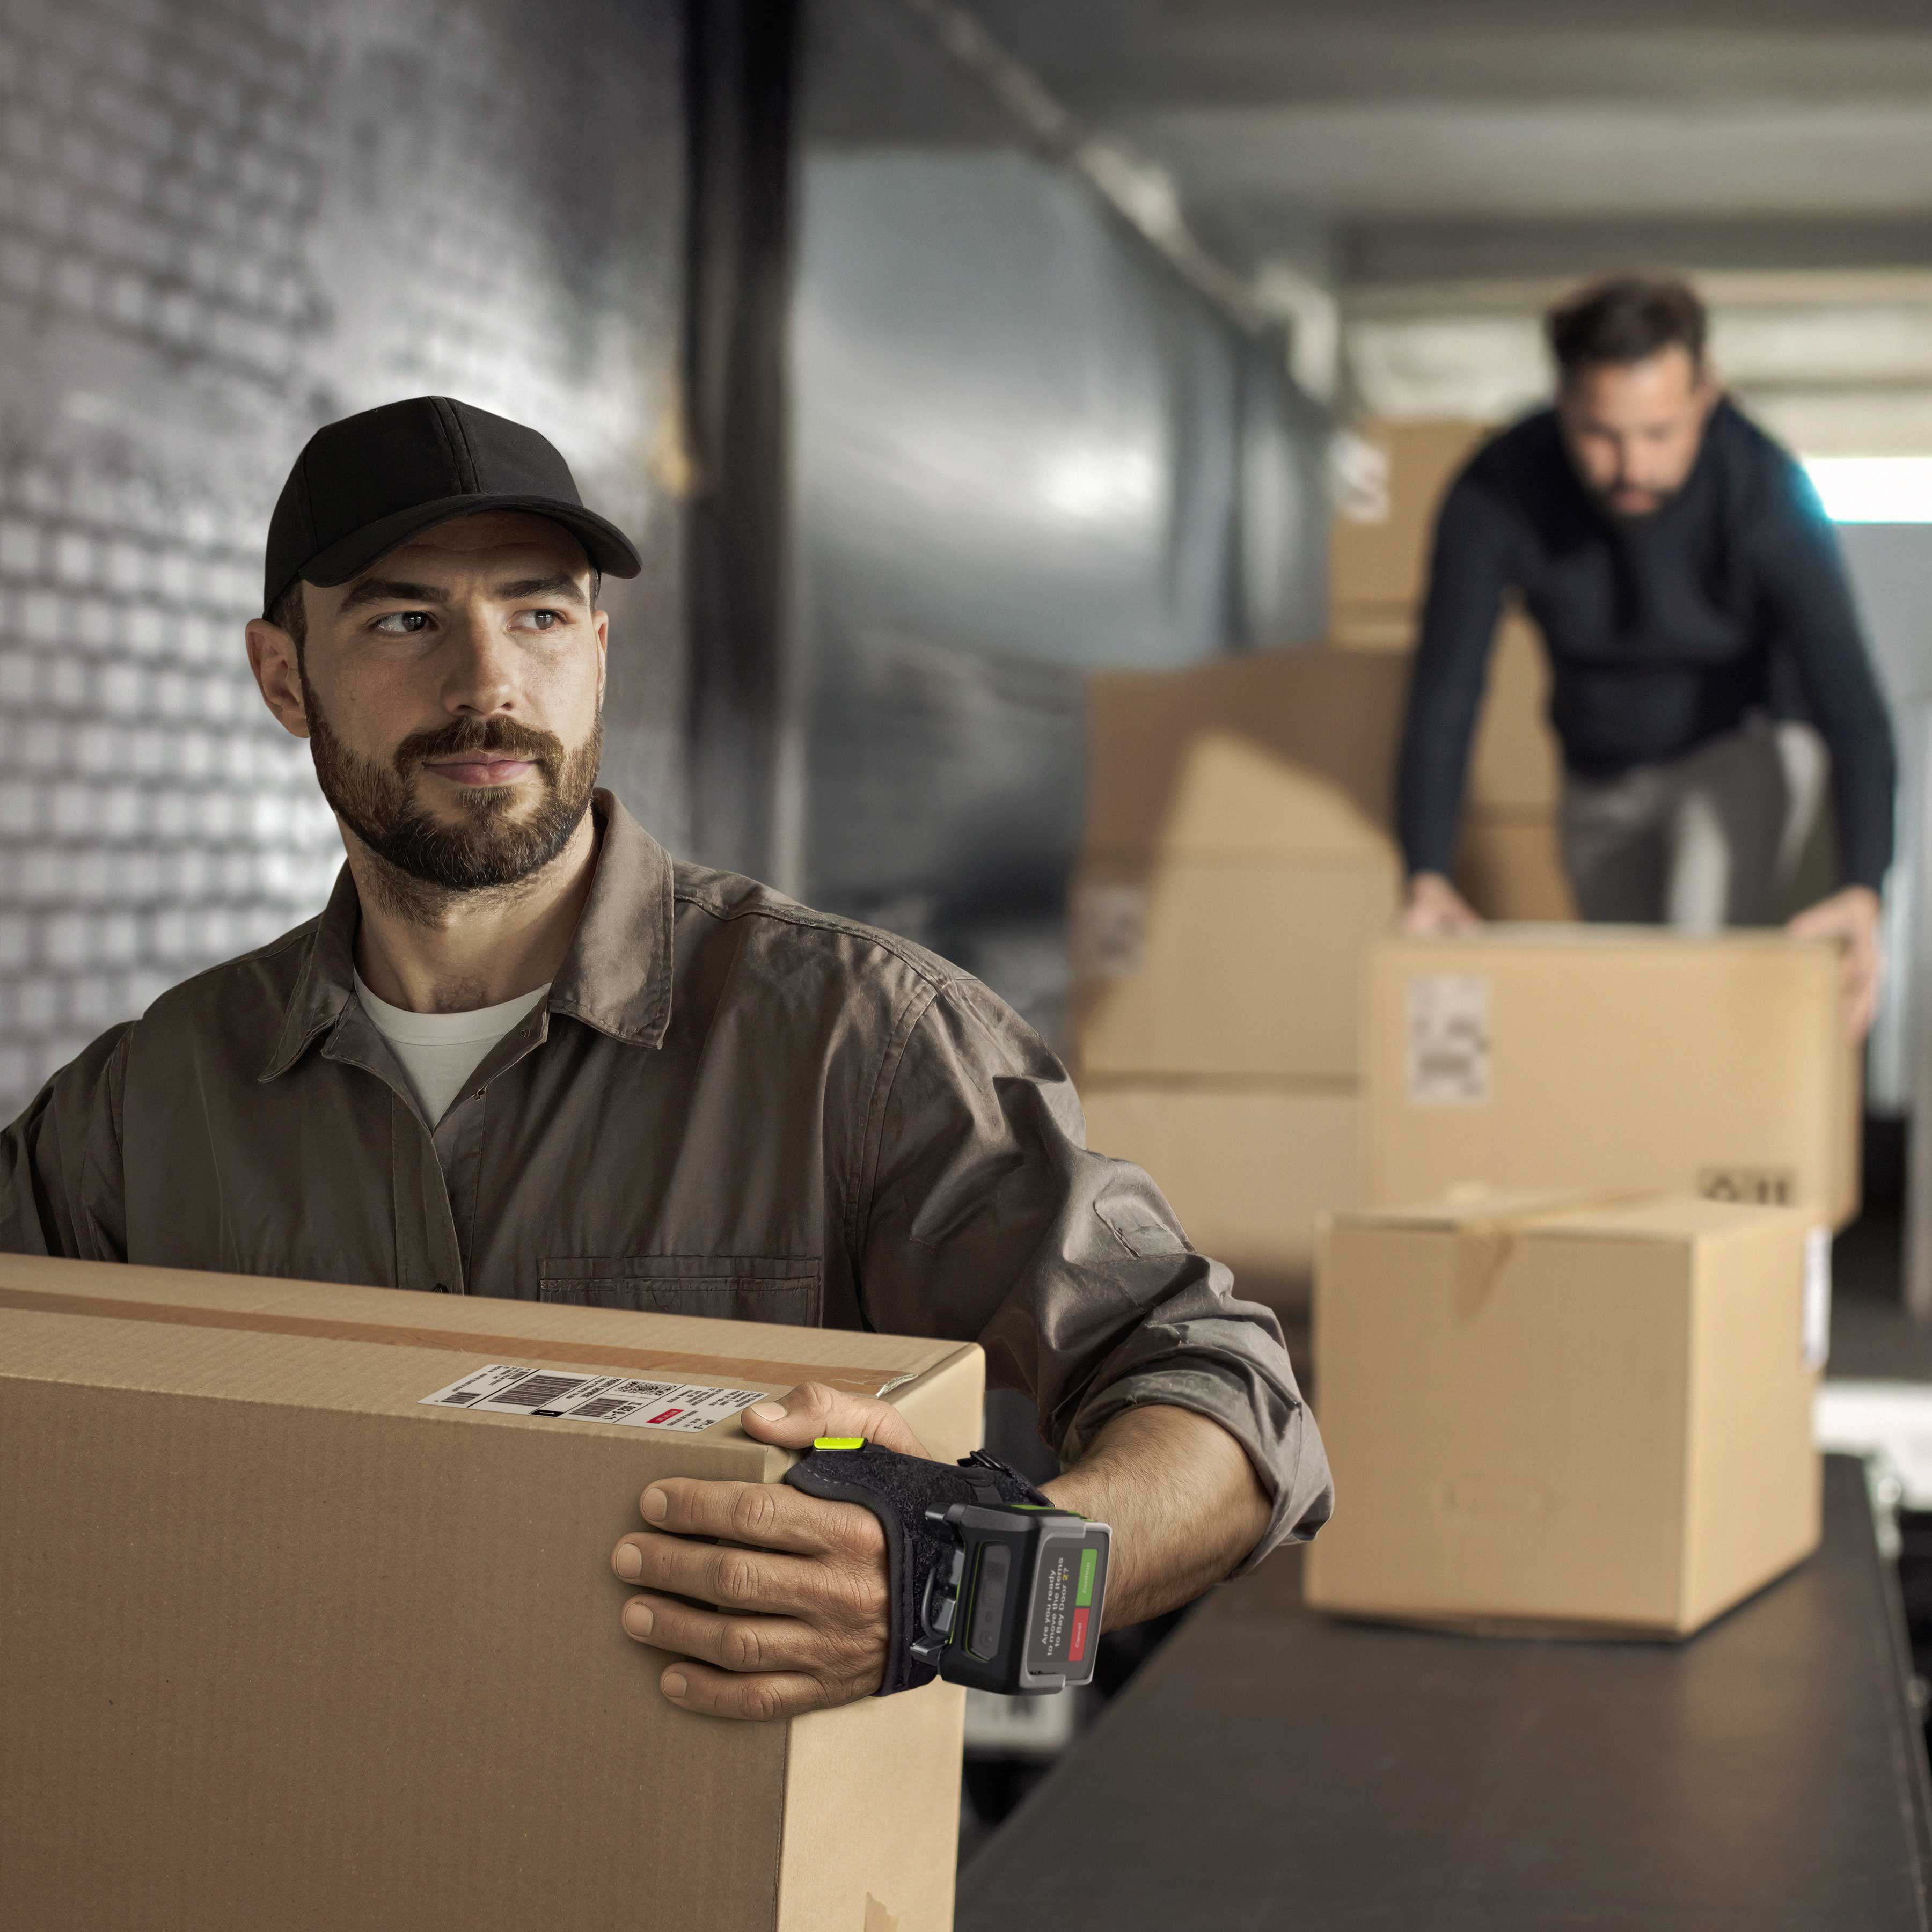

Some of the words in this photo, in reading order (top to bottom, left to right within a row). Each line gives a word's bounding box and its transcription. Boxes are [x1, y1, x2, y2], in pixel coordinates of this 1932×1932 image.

[1048, 1570, 1056, 1601] ready
[1059, 1584, 1067, 1611] Door
[1047, 1645, 1053, 1656] to
[1055, 1557, 1063, 1590] items
[1056, 1613, 1064, 1633] Bay
[1055, 1636, 1060, 1647] to
